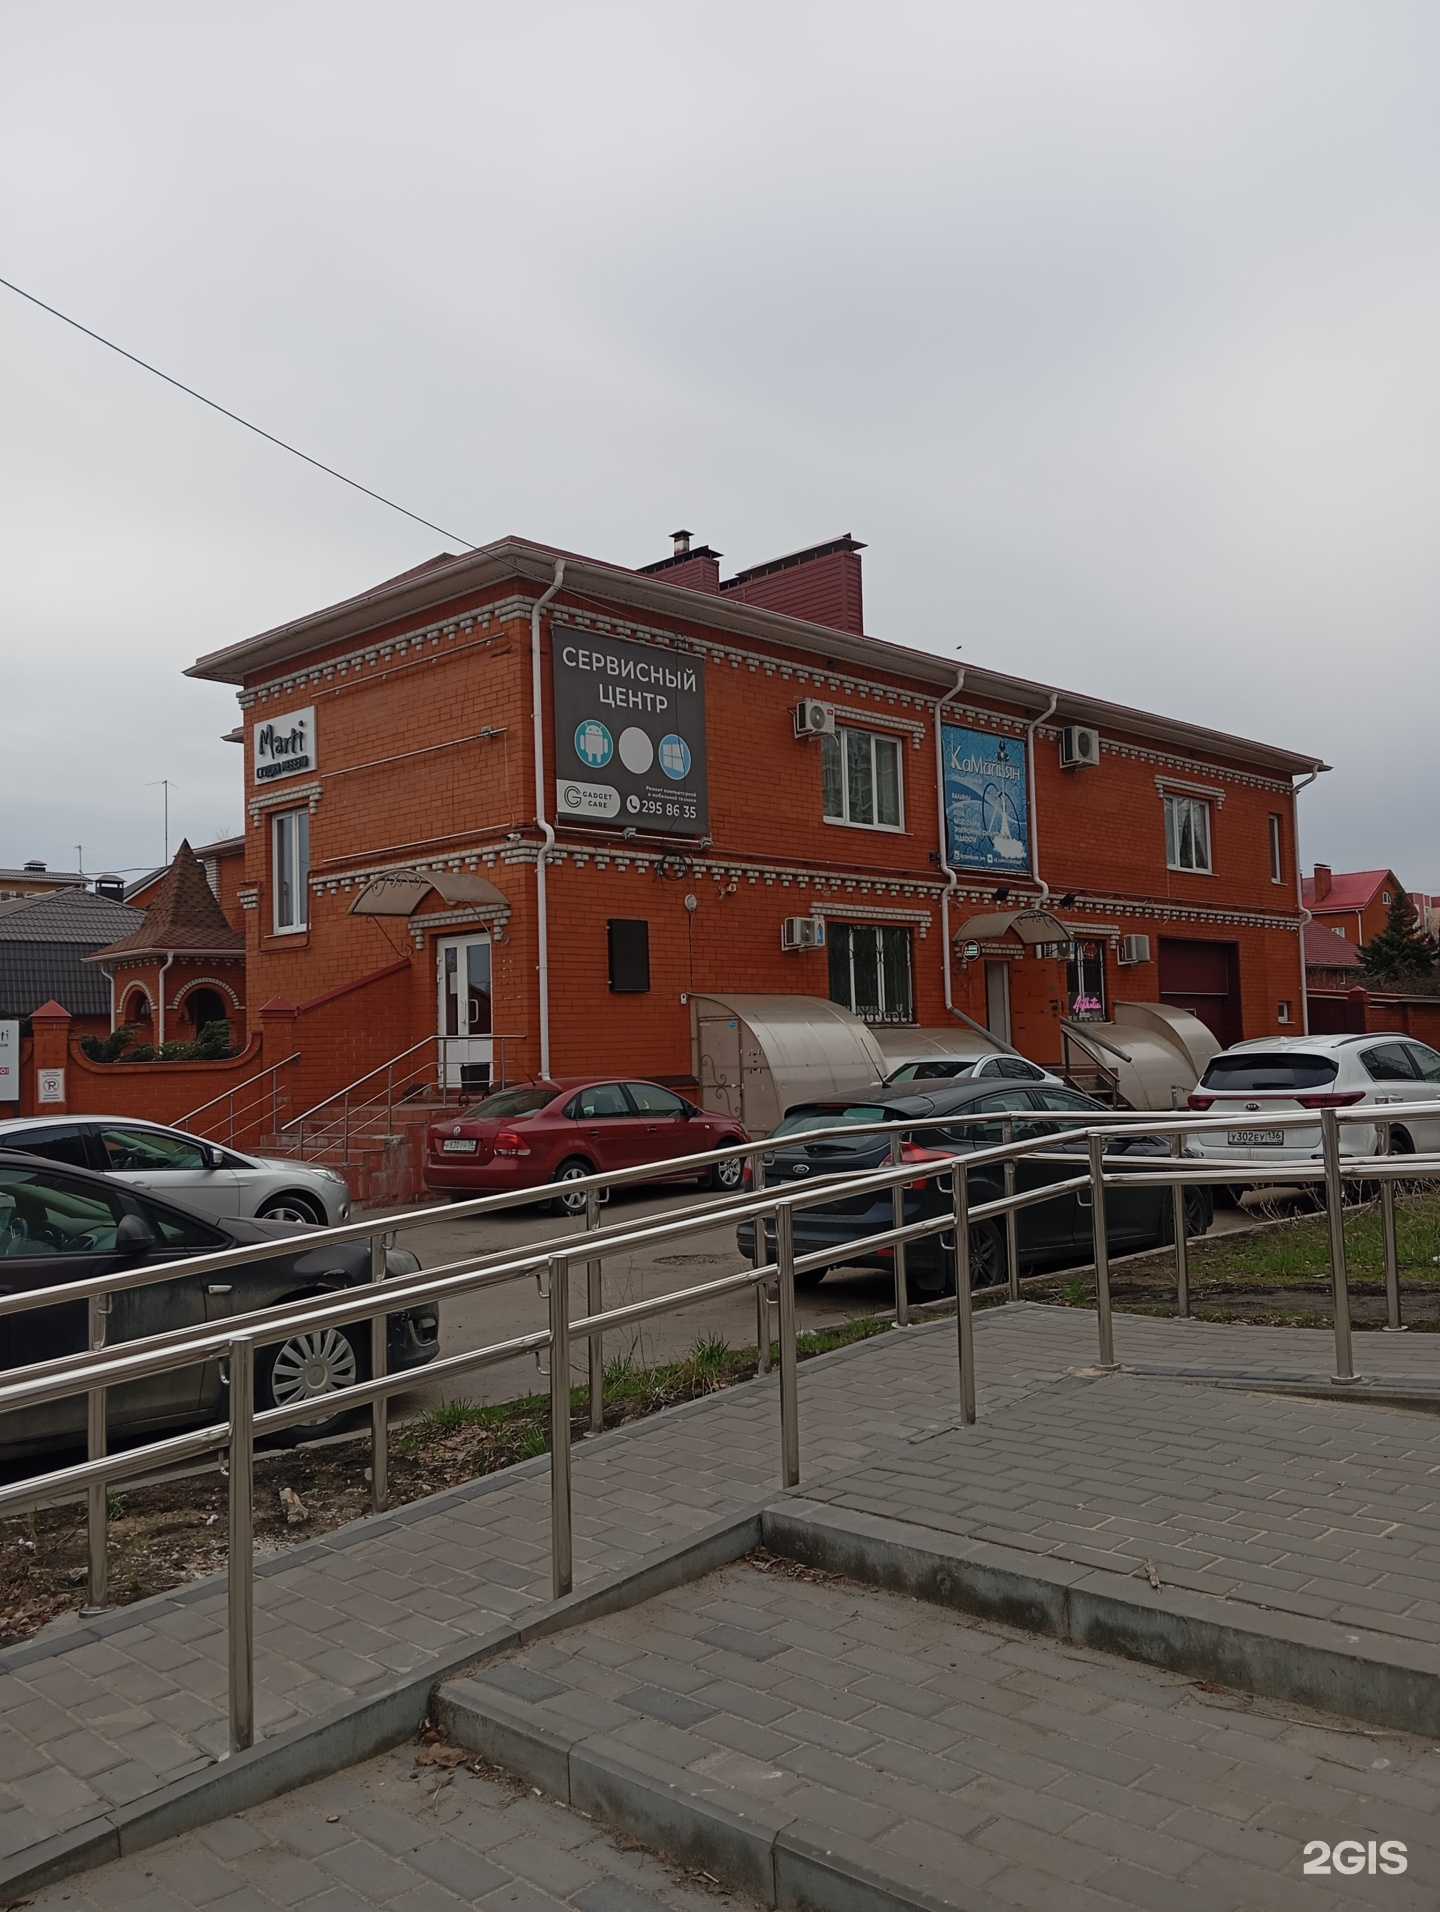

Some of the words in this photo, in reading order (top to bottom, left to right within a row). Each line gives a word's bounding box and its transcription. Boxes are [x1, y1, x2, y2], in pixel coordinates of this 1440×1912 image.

[562, 646, 697, 692] СЕРВИСНЫЙ
[598, 683, 668, 713] ЦЕНТР
[258, 720, 305, 760] Marti
[582, 791, 612, 801] GADGET
[587, 800, 608, 809] CARE
[641, 800, 663, 814] 295
[666, 803, 680, 817] 86
[683, 805, 697, 819] 35
